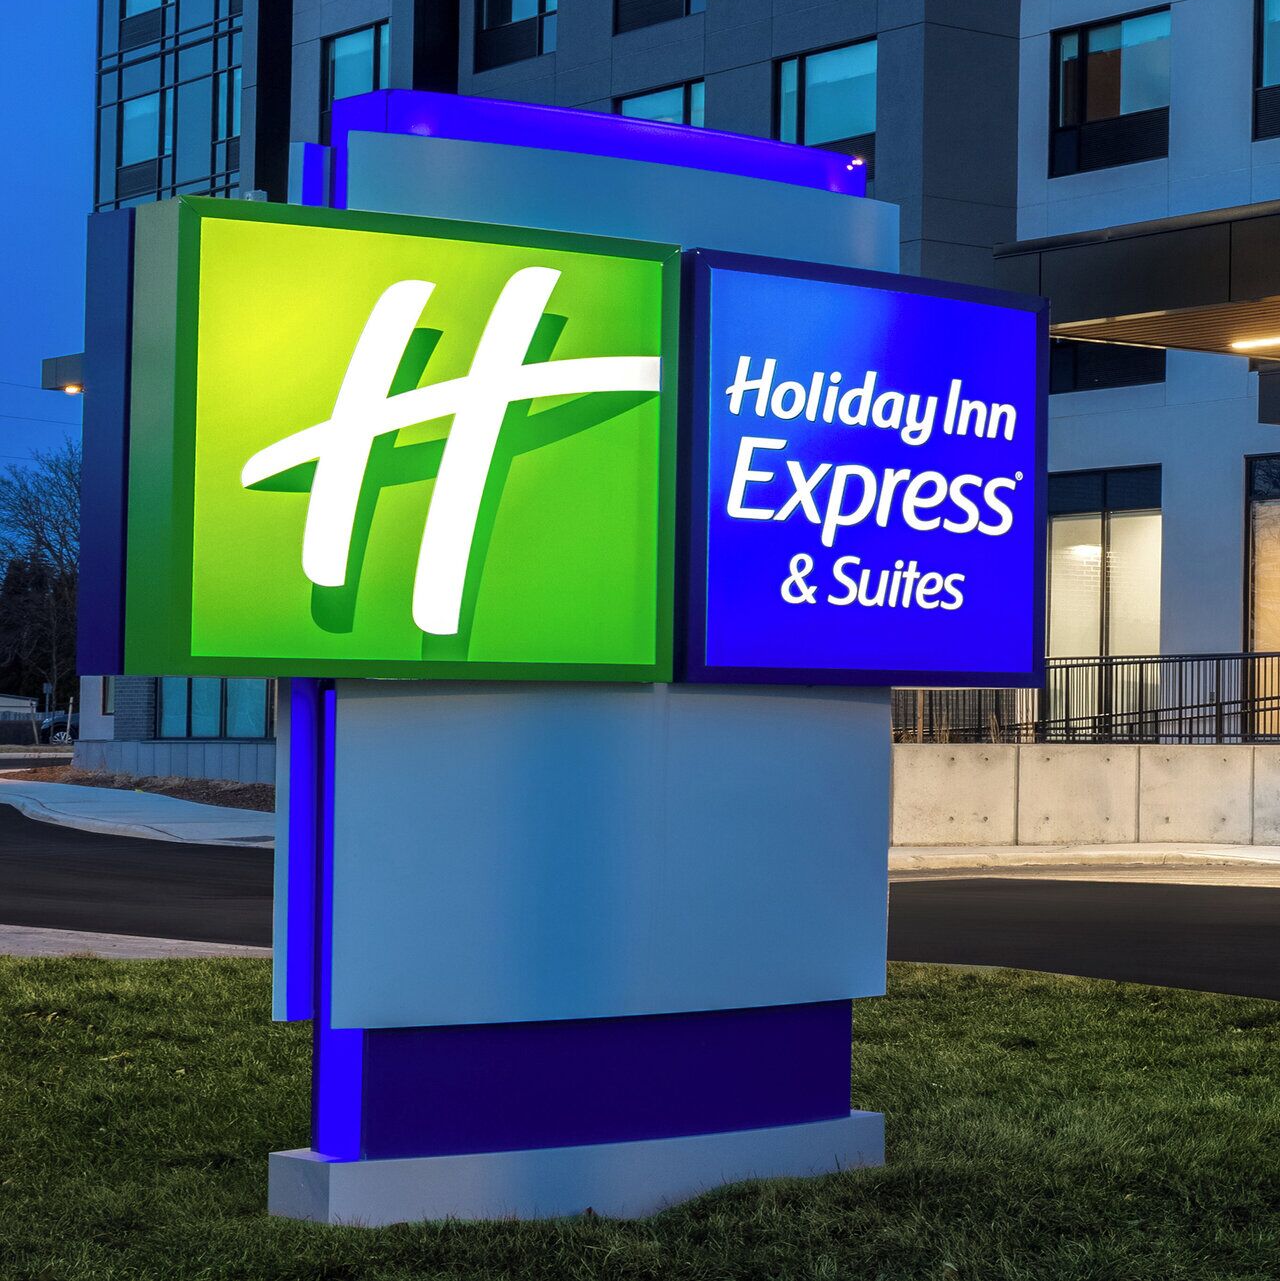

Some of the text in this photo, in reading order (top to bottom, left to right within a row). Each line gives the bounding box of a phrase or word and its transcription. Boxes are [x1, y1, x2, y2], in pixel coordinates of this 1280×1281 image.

[725, 355, 1017, 447] Holiday Inn
[780, 552, 966, 611] & Suites
